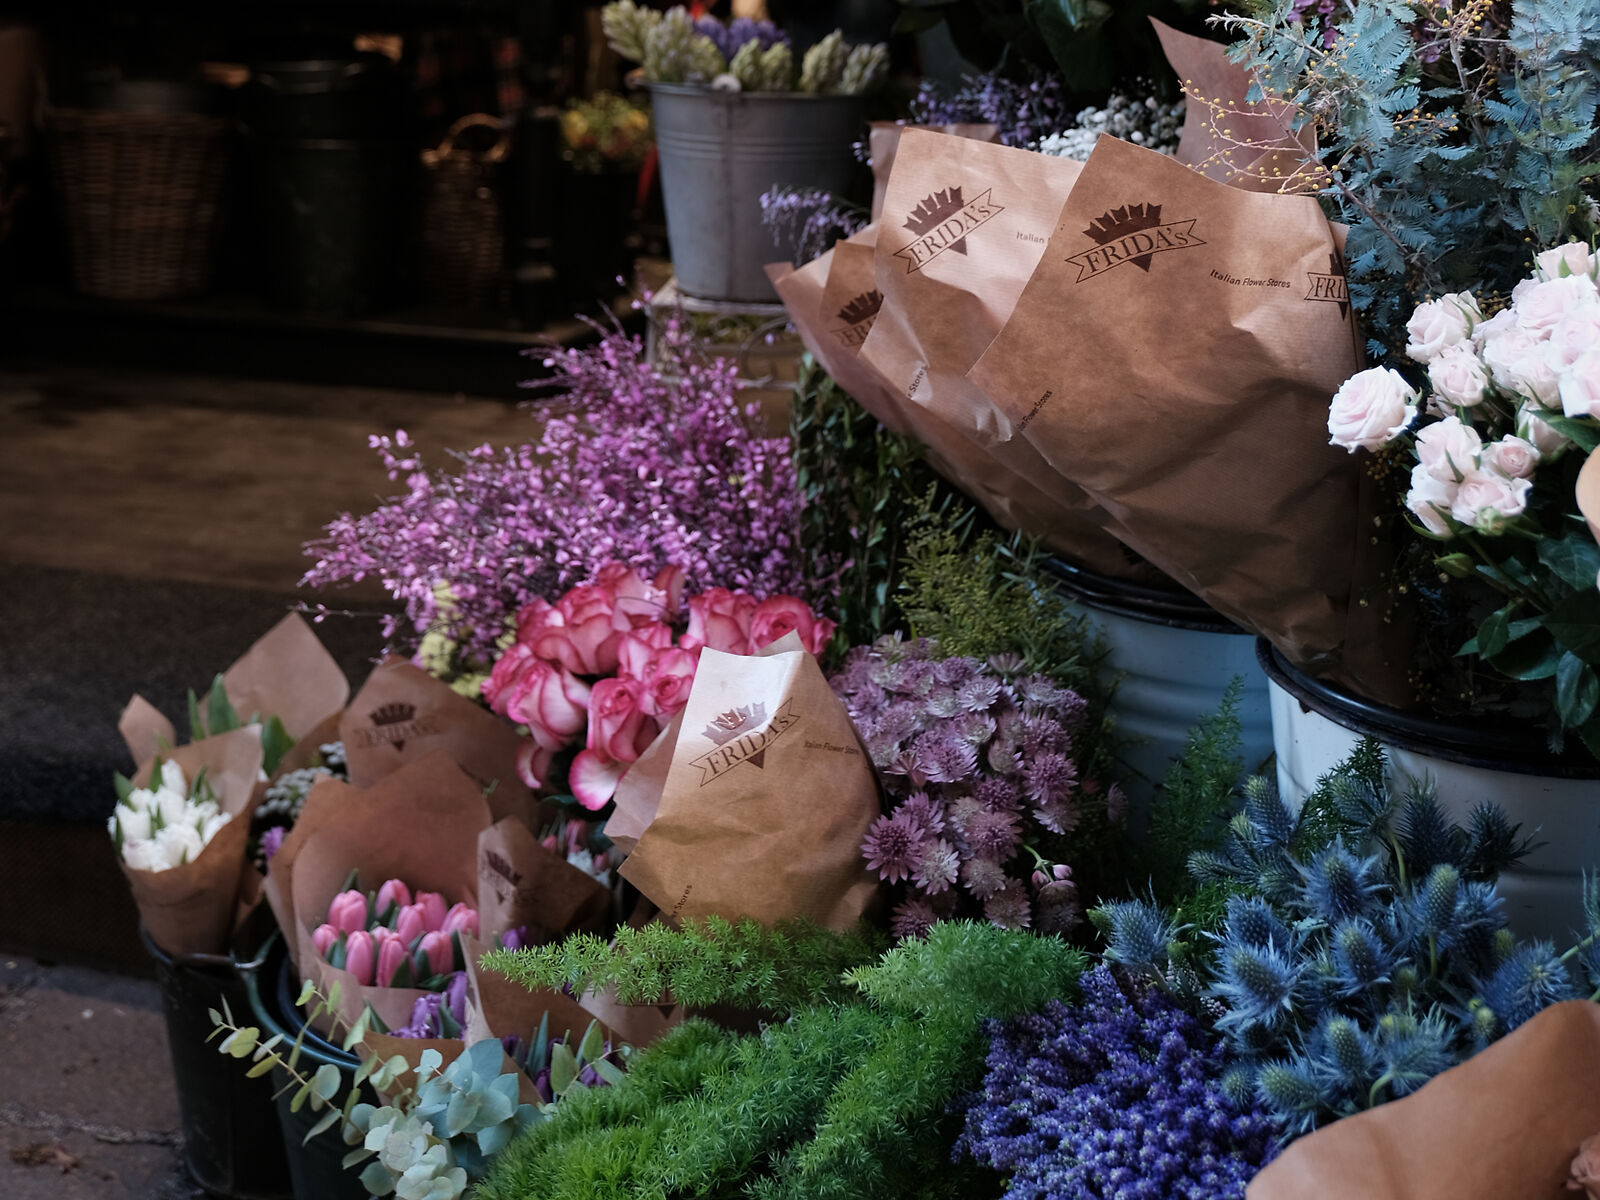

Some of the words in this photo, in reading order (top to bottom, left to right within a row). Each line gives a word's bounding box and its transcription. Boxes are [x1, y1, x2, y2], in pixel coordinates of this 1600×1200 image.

[908, 204, 992, 265] FRIDA's
[1016, 231, 1045, 244] Italian
[1084, 227, 1189, 273] FRIDA's
[1210, 269, 1241, 286] Italian
[1242, 277, 1266, 287] Flower
[1266, 278, 1291, 289] Stores
[706, 714, 790, 776] FRIDA's
